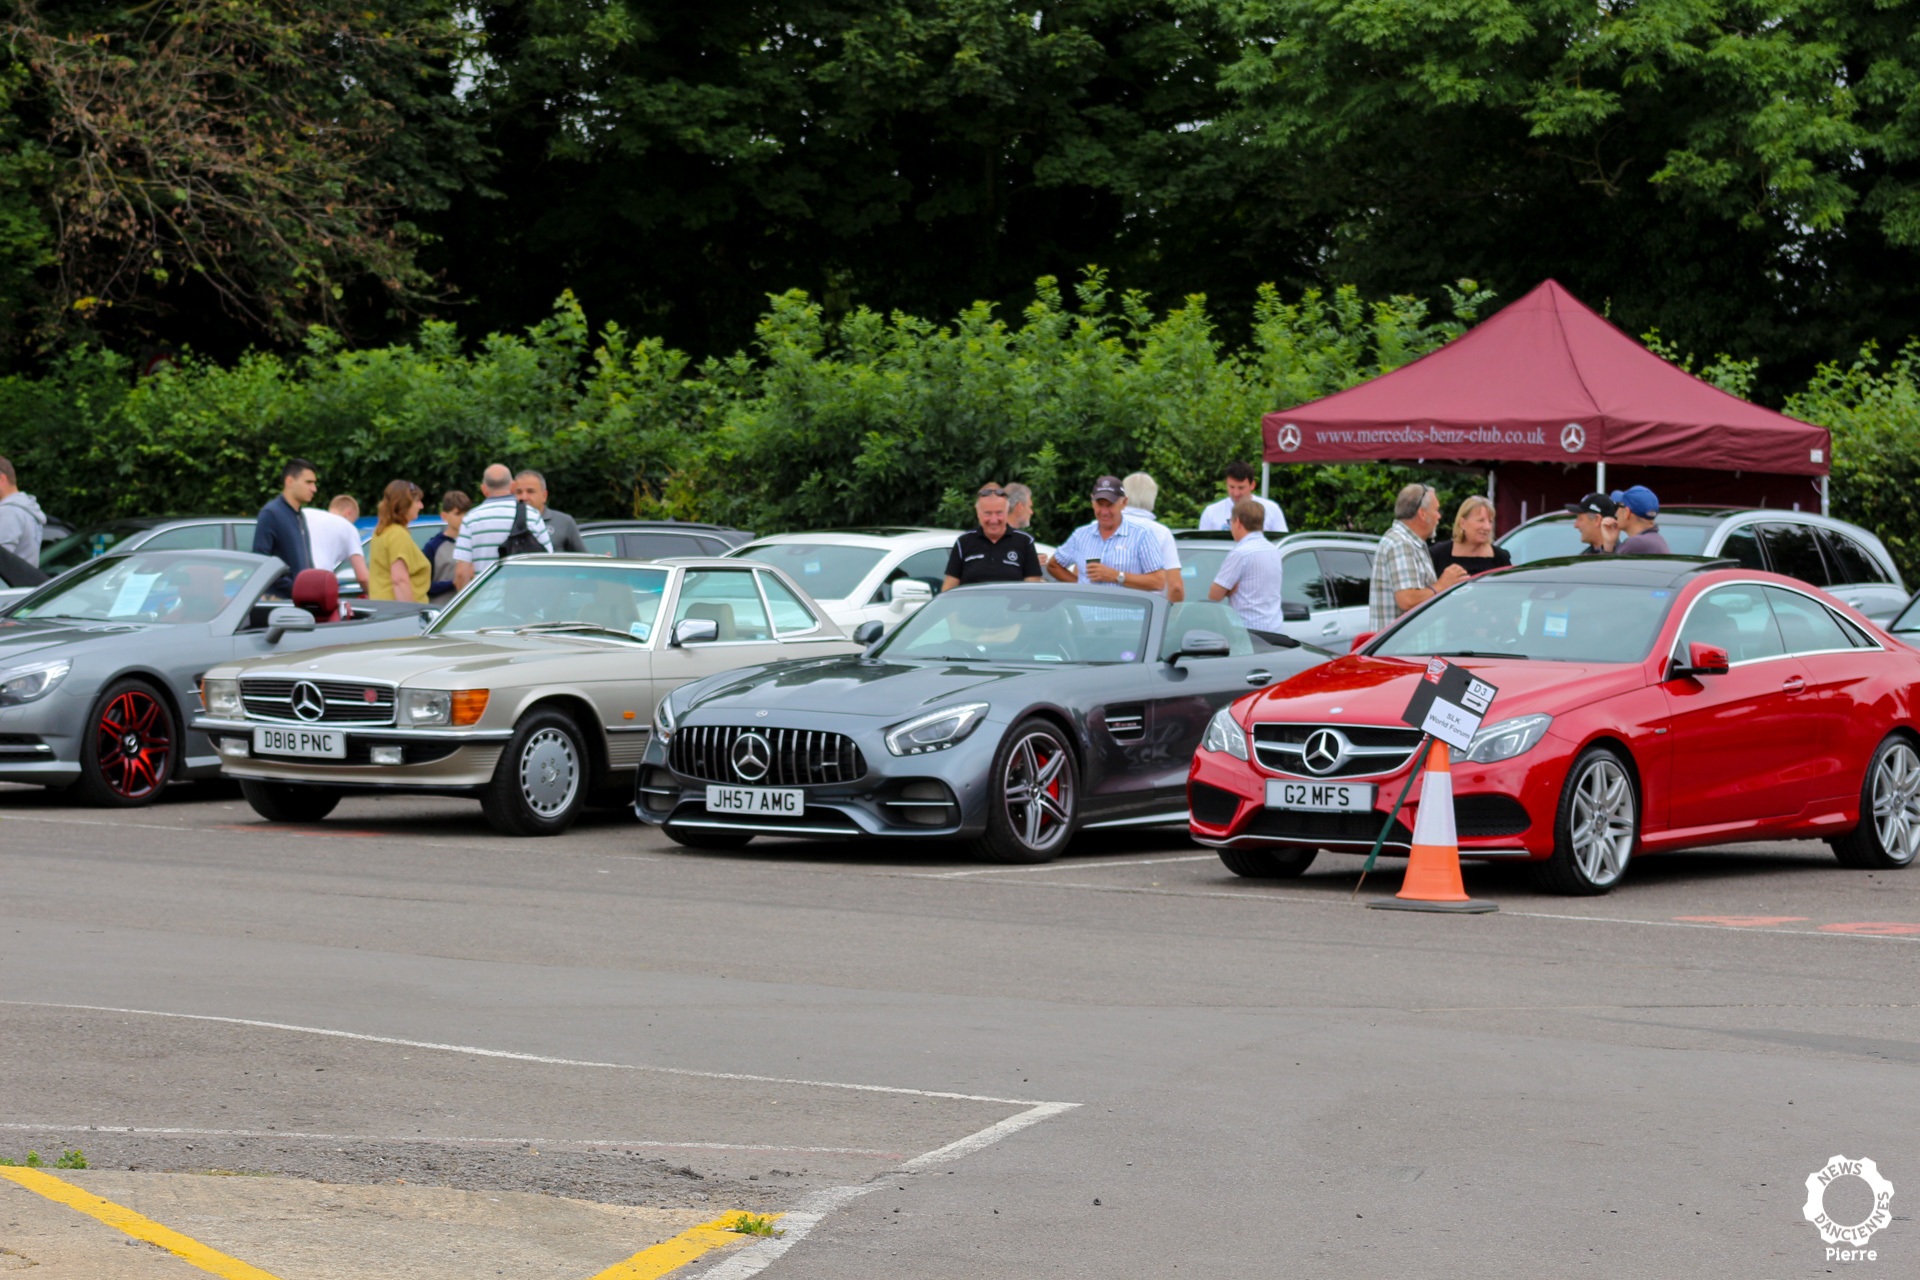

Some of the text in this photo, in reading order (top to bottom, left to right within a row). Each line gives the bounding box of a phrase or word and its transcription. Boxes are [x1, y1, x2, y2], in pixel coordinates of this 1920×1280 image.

[1316, 426, 1546, 445] www.mercedes-benz-club.co.uk
[1429, 713, 1471, 740] World Forum
[1446, 713, 1462, 725] SLK
[264, 731, 333, 752] D818 PNC
[713, 789, 795, 811] JH57 AMG
[1284, 784, 1350, 806] G2 MFS
